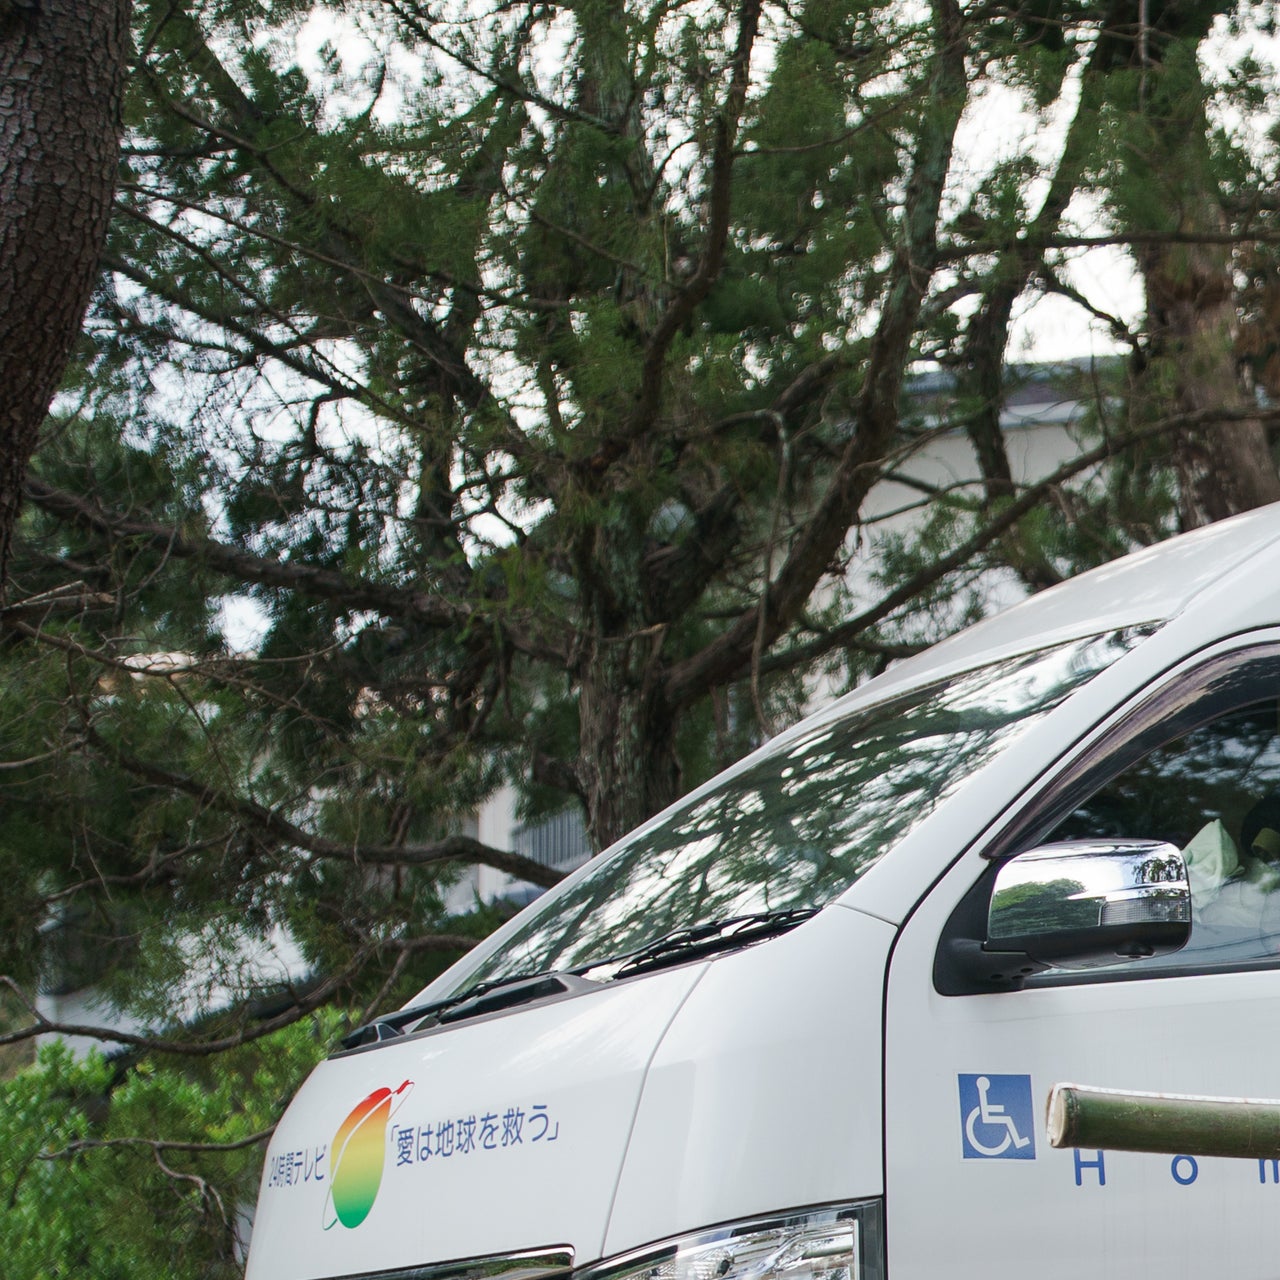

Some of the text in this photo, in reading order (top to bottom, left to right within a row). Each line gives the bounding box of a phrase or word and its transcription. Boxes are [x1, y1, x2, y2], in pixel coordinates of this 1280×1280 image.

[390, 1104, 560, 1167] 「愛は地球を救う」
